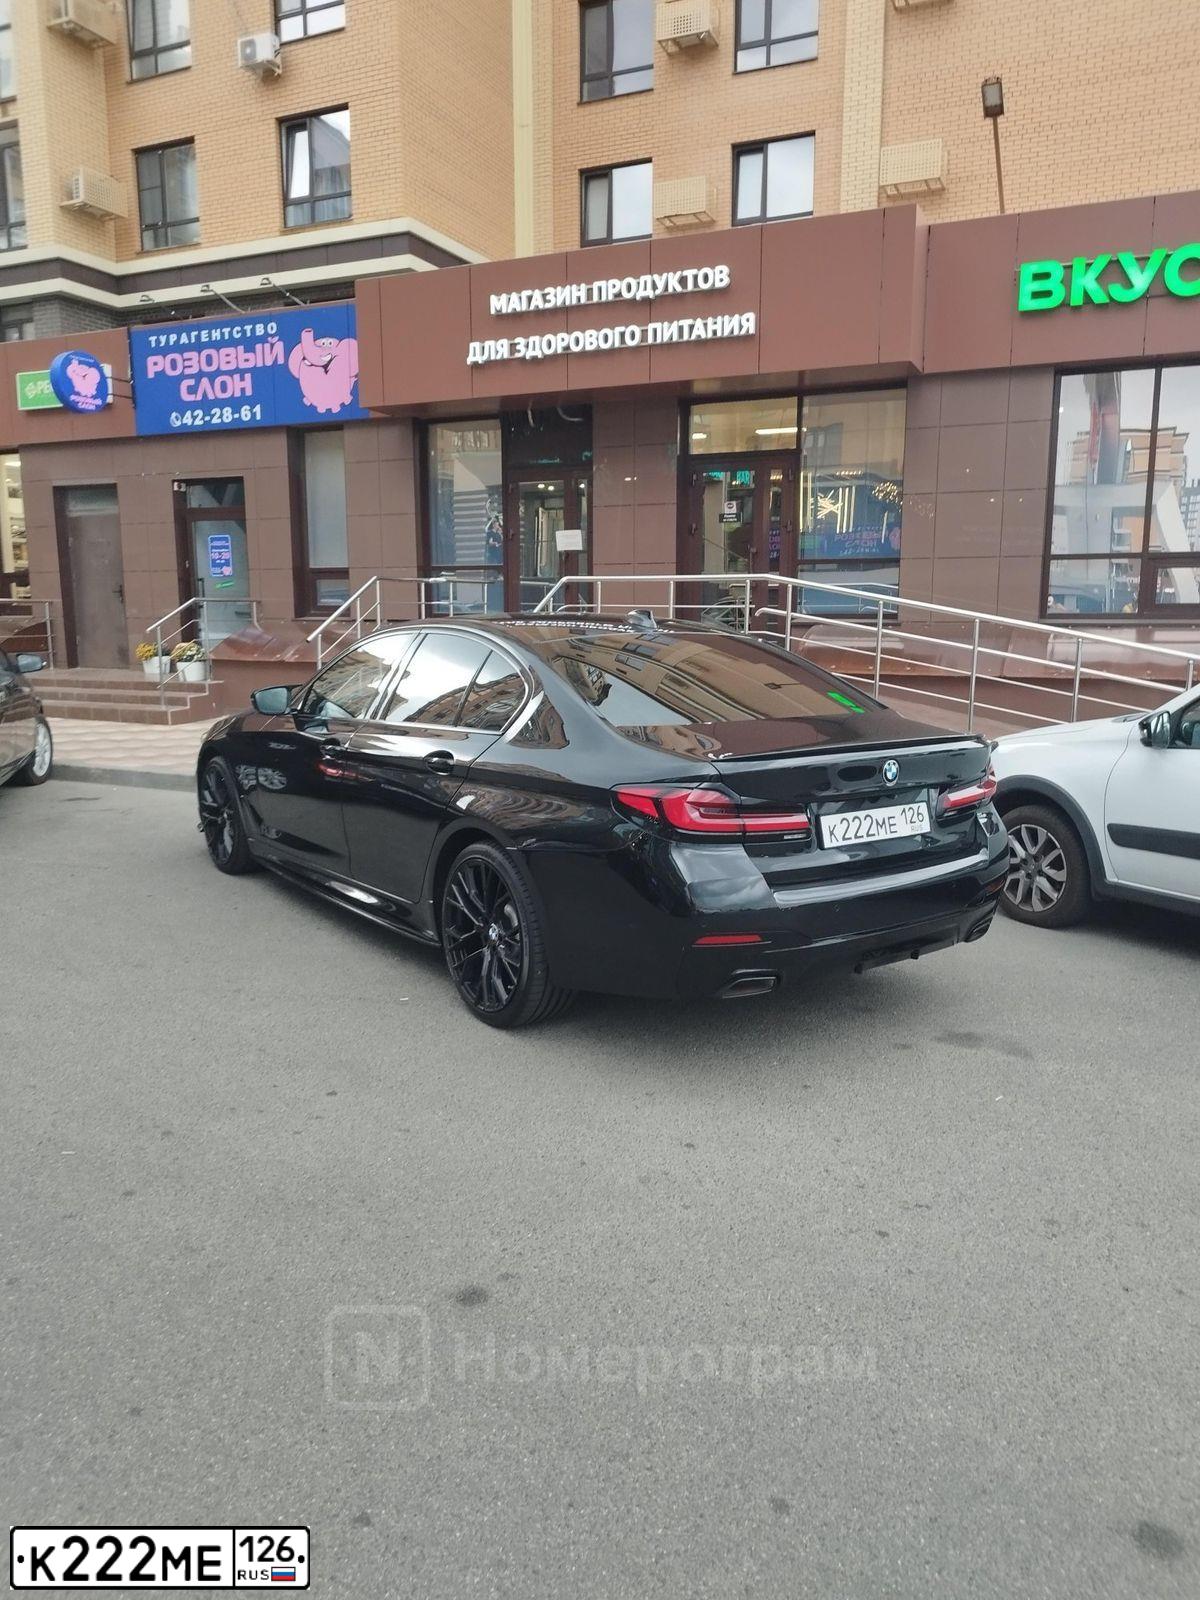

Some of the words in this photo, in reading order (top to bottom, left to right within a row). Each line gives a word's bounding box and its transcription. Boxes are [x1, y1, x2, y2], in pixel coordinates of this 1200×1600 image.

[489, 283, 586, 315] МАГАЗИН
[592, 265, 730, 300] ПРОДУКТОВ
[149, 322, 277, 347] ТУРАГЕНТСТВО
[467, 341, 509, 365] ДЛЯ
[514, 324, 642, 360] ЗДОРОВОГО
[647, 312, 756, 343] ПИТАНИЯ
[146, 336, 284, 378] РОЗОВЫЙ
[179, 372, 253, 402] СЛОН
[182, 404, 262, 426] 42-28-61
[829, 814, 898, 843] К222МЕ
[900, 806, 924, 825] 126
